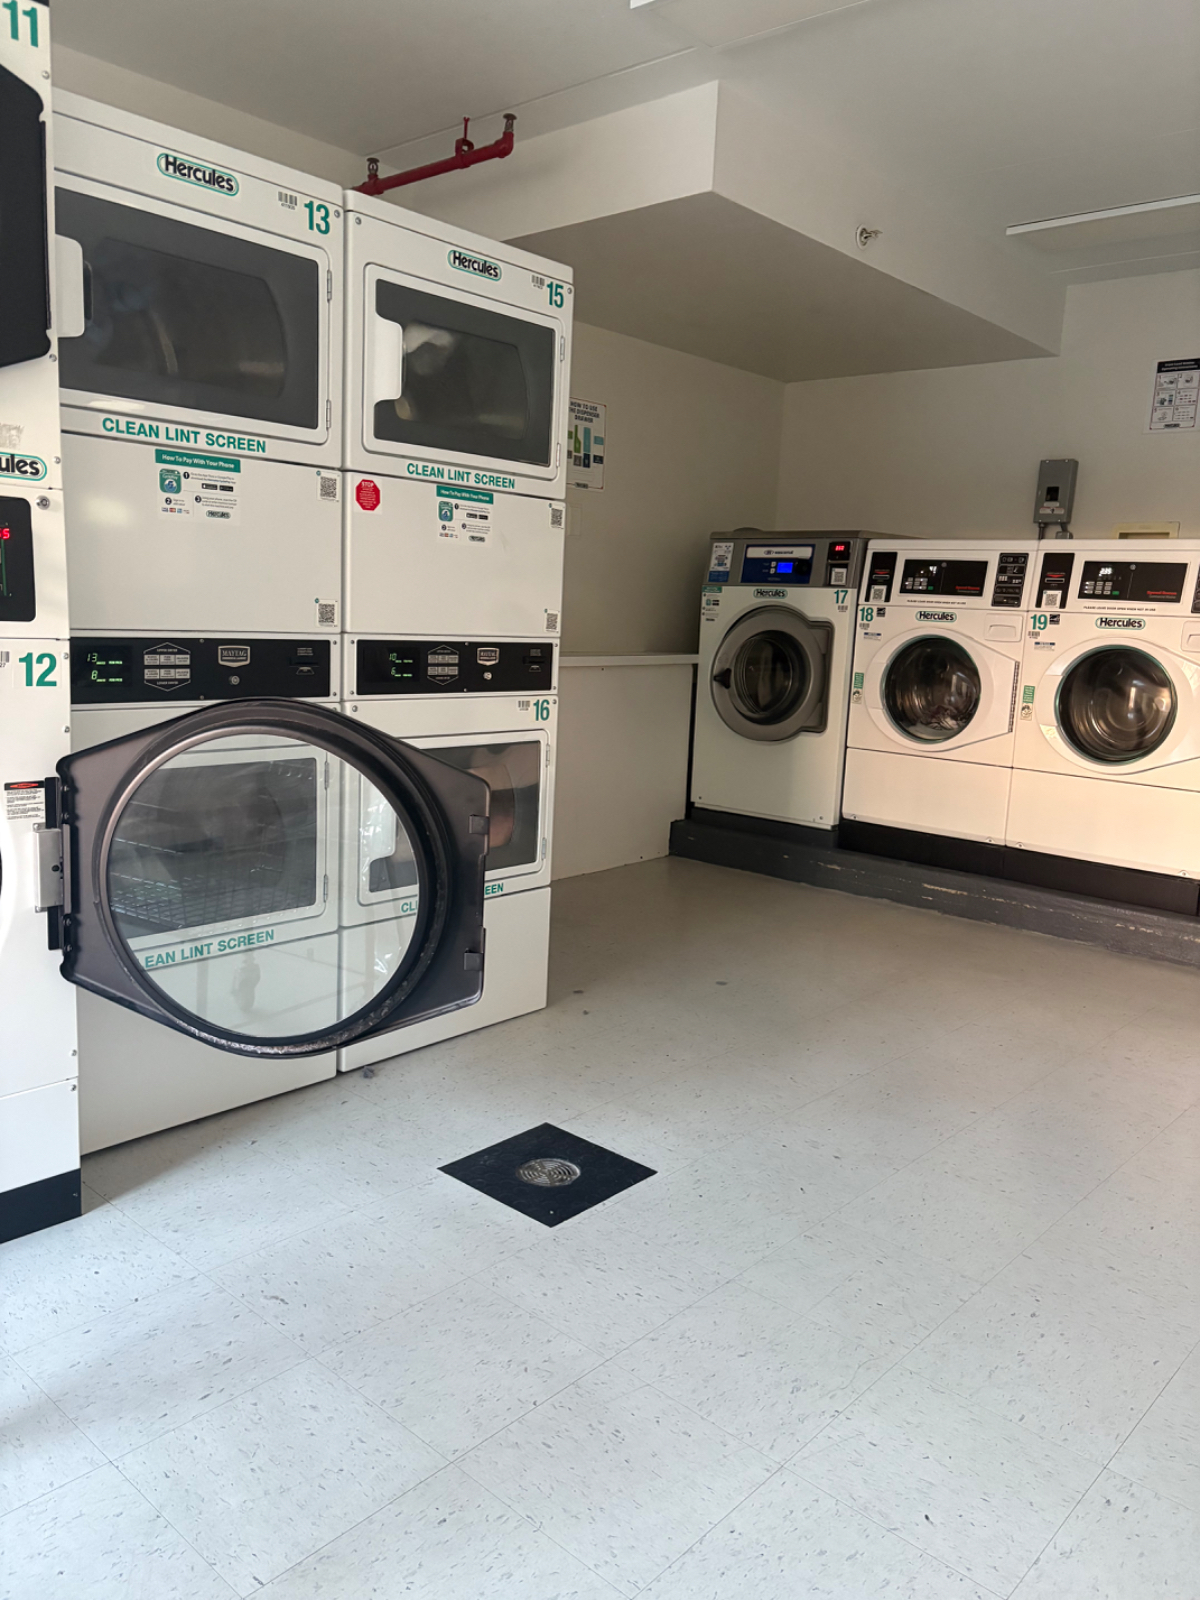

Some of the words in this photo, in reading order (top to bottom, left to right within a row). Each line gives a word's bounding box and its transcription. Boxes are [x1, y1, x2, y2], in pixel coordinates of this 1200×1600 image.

[2, 0, 38, 48] 11
[164, 154, 234, 192] Hercules
[304, 200, 330, 235] 13
[452, 250, 499, 278] Hercules
[546, 281, 564, 309] 15
[102, 417, 159, 439] CLEAN
[165, 426, 200, 444] LINT
[205, 433, 266, 453] SCREEN
[407, 463, 444, 479] CLEAN
[448, 468, 471, 482] LINT
[474, 473, 515, 489] SCREEN
[756, 589, 786, 598] Hercules
[834, 590, 848, 604] 17
[859, 607, 873, 622] 18
[919, 611, 954, 621] Hercules
[1030, 614, 1048, 630] 19
[1100, 617, 1143, 628] Hercules
[19, 652, 57, 687] 12
[533, 699, 550, 721] 16
[181, 942, 213, 960] LINT
[217, 929, 274, 953] SCREEN
